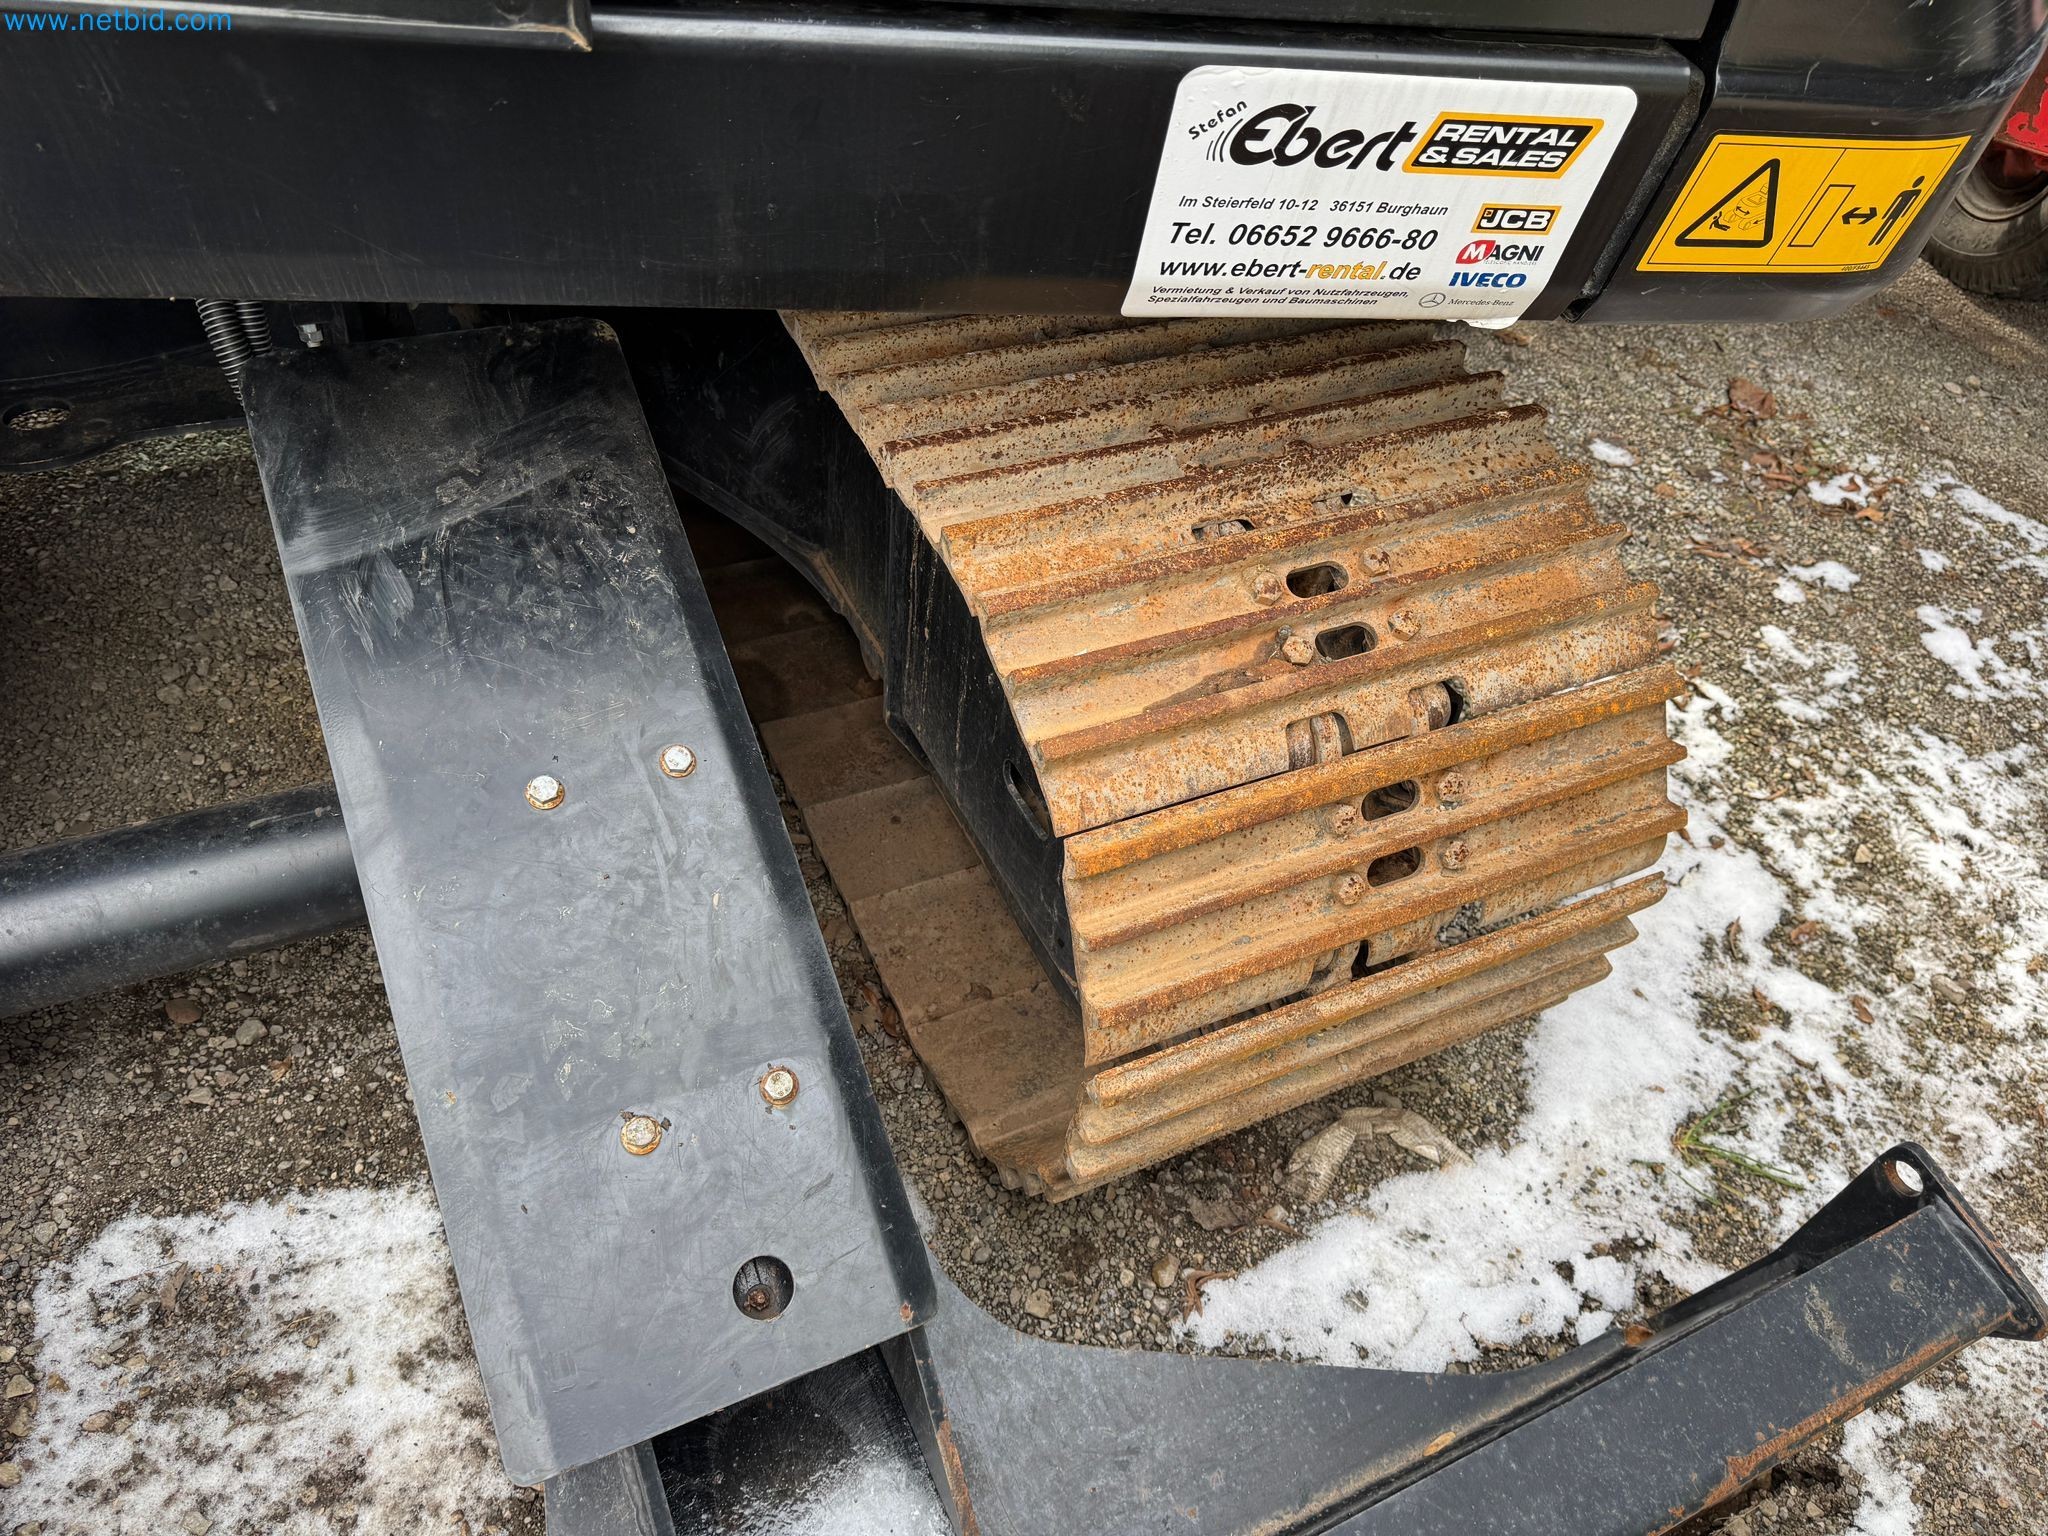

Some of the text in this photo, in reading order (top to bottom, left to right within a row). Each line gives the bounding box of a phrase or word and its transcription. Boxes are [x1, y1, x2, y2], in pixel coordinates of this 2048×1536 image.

[1188, 100, 1248, 140] Stefan
[1229, 103, 1417, 172] Ebert
[1434, 123, 1580, 147] RENTAL
[1417, 146, 1568, 169] & SALES
[1178, 195, 1449, 217] Im Steierfeld 10-12 36151 Burghaun
[1480, 209, 1551, 230] JCB
[1170, 222, 1438, 250] Tel. 06652 9666-80
[1461, 243, 1545, 262] MAGNI
[1159, 258, 1422, 281] www.ebert-rental.de
[1449, 272, 1527, 288] IVECO
[1147, 295, 1260, 305] Spezialfahrzeugen
[1288, 297, 1378, 305] Baumaschinen
[1152, 286, 1222, 296] Vermietung
[1239, 287, 1287, 295] Verkauf
[1312, 288, 1409, 298] Nutzfahrzeugen,
[1447, 298, 1515, 306] Mercedes-Benz
